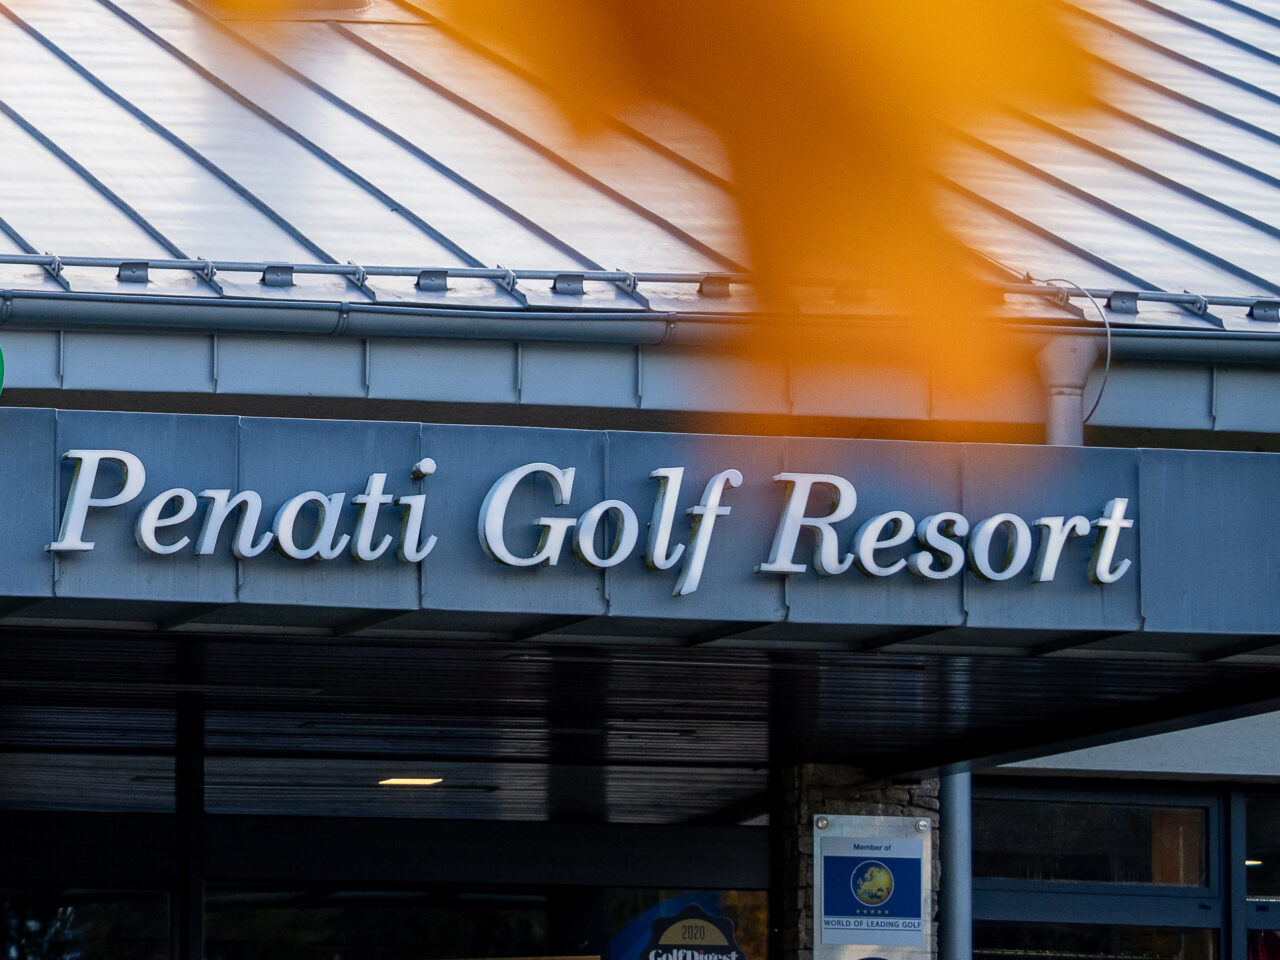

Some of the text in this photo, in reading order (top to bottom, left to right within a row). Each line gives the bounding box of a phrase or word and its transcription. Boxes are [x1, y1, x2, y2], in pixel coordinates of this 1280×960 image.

[44, 449, 1134, 597] Penati Golf Resort
[853, 843, 883, 851] Member
[824, 919, 851, 927] WORLD
[866, 920, 900, 928] LEADING
[902, 921, 922, 929] GOLF
[682, 925, 705, 940] 2020
